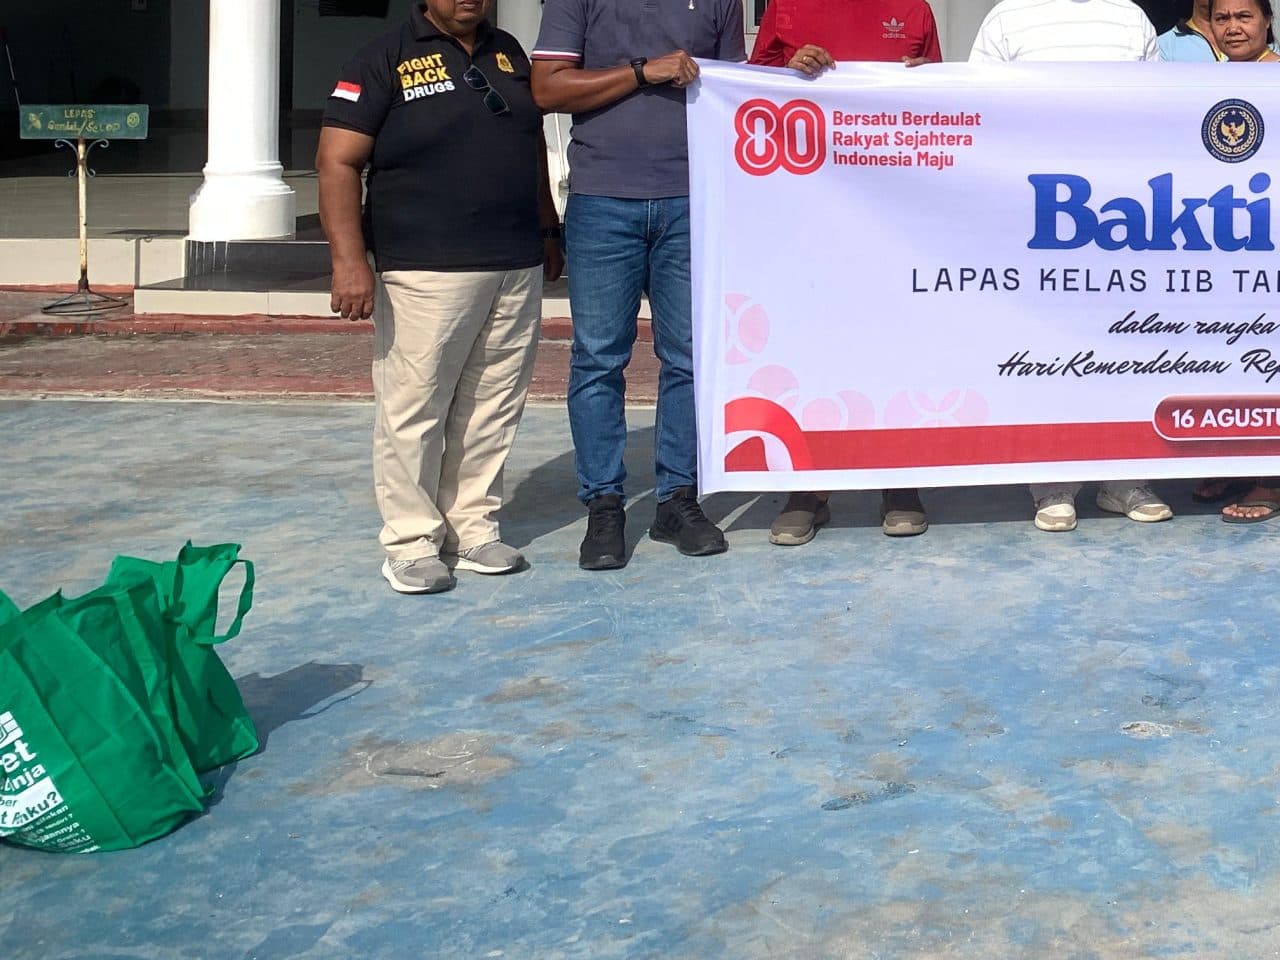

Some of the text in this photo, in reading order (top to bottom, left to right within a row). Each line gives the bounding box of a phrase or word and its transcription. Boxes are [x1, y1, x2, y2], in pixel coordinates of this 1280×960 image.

[397, 53, 443, 74] FIGHT
[400, 66, 452, 89] BACK
[403, 80, 455, 102] DRUGS
[832, 111, 982, 127] Bersatu Berdaulat
[734, 98, 827, 177] 80
[832, 130, 973, 150] Rakyat Sejahtera
[832, 151, 954, 170] Indonesia Maju
[1026, 172, 1276, 252] Bakti
[912, 267, 1020, 293] LAPAS
[1039, 268, 1147, 293] KELAS
[1165, 269, 1213, 293] IIB
[1107, 310, 1190, 335] dalam
[1192, 312, 1280, 345] rangka
[997, 350, 1062, 377] Hari
[1061, 349, 1232, 377] Kemerdekaan
[1171, 409, 1195, 428] 16
